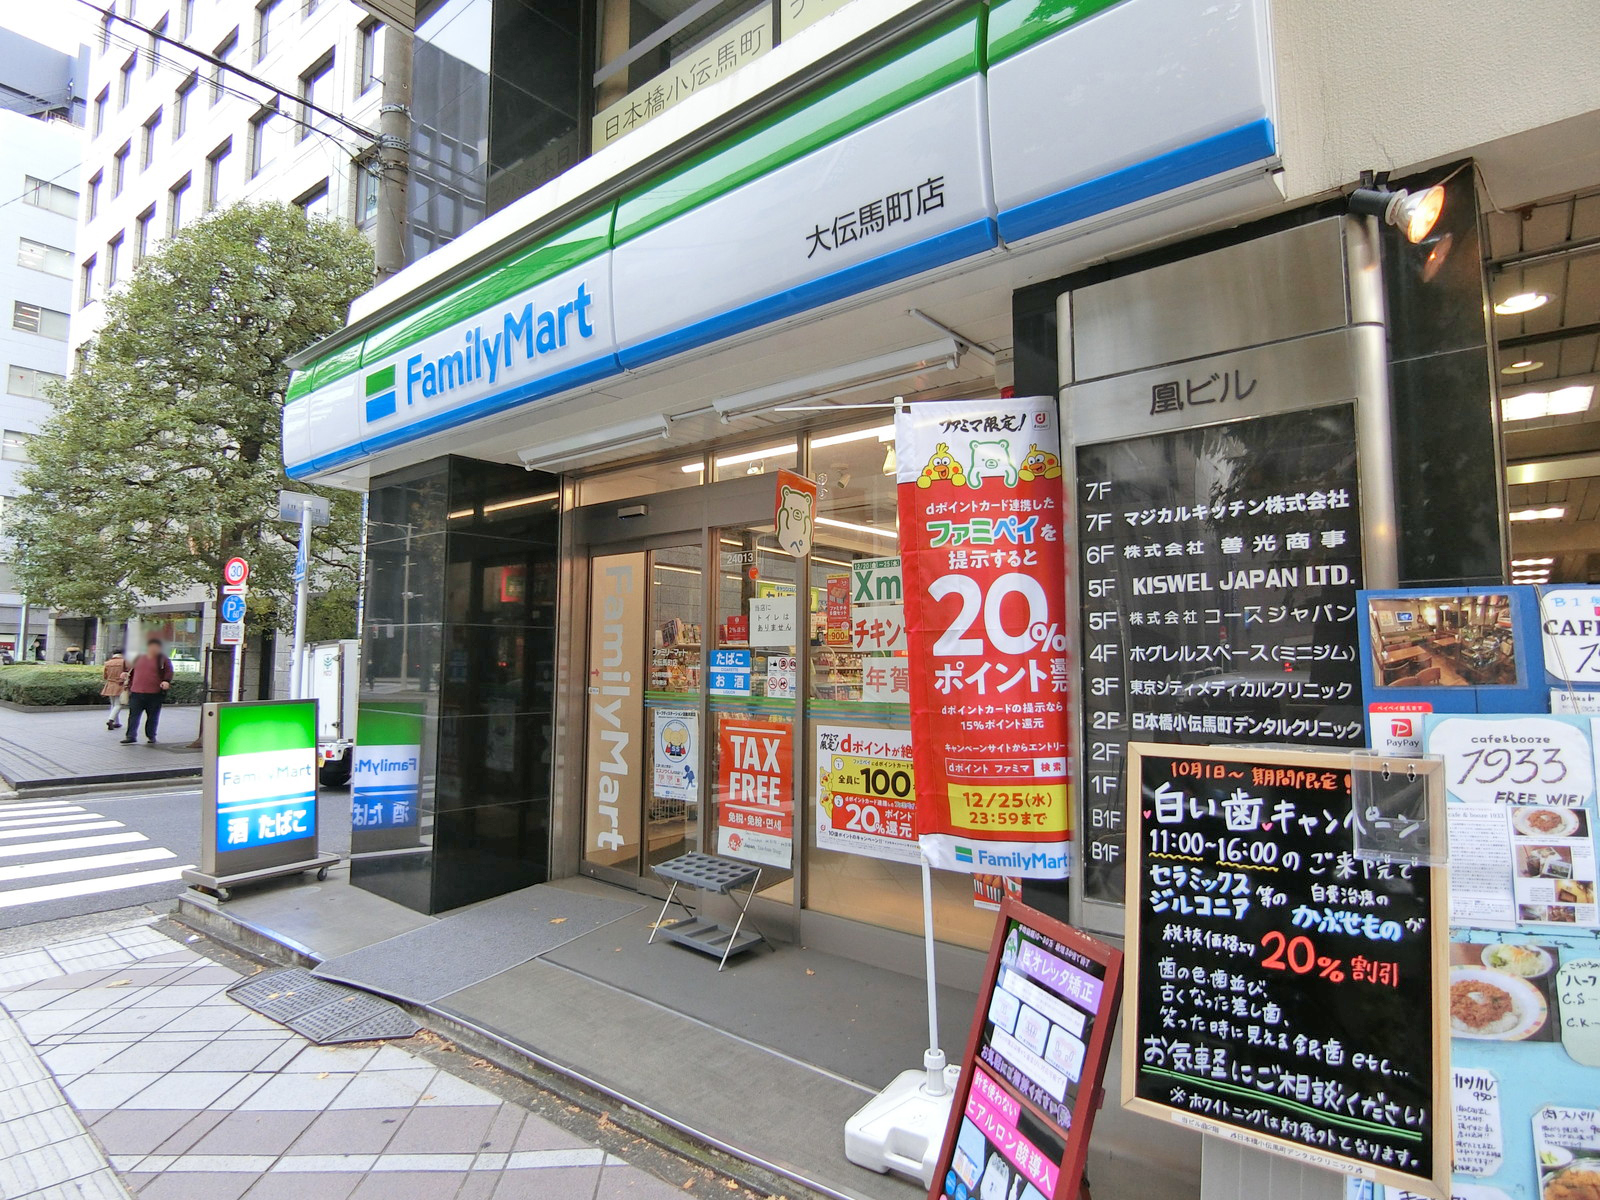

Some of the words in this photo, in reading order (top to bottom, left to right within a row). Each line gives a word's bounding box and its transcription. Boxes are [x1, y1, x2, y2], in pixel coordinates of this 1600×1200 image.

[605, 23, 766, 141] 日本橋小伝馬町
[805, 175, 945, 258] 大伝馬町店
[407, 281, 593, 405] FamilyMart
[1086, 481, 1112, 502] 7F
[926, 496, 1054, 516] dポイントカード連携した
[1086, 513, 1112, 533] 7F
[1124, 488, 1350, 527] マジカルキッチン株式会社
[727, 552, 754, 564] 24013
[948, 548, 1038, 570] 提示すると
[1086, 544, 1114, 565] 6F
[1123, 540, 1205, 560] 株式会社
[230, 565, 242, 577] 30
[1088, 578, 1115, 598] 5F
[1132, 572, 1213, 596] KISWEL
[1219, 567, 1298, 590] JAPAN
[1306, 564, 1356, 587] LTD.
[928, 572, 1067, 656] 20%
[1089, 611, 1117, 631] 5F
[1129, 610, 1198, 625] 株式会社
[1205, 605, 1356, 625] コースジャパン
[757, 623, 792, 632] ありません
[716, 652, 744, 665] たばこ
[1089, 644, 1118, 663] 4F
[1129, 644, 1355, 662] ホグレルスペース(ミニジム)
[934, 659, 1047, 695] ポイント
[1091, 677, 1119, 696] 3F
[1130, 679, 1353, 699] 東京シティメディカルクリニック
[593, 565, 633, 851] FamilyMart
[941, 701, 1063, 715] dポイントカードの提示なら
[960, 718, 1045, 731] 15%ポイント還元
[1093, 712, 1120, 730] 2F
[1132, 712, 1362, 740] 日本橋小伝馬町デンタルクリニック
[1386, 738, 1420, 749] PayPay
[1471, 734, 1550, 744] cafe&booze
[730, 735, 781, 773] TAX
[1092, 743, 1120, 762] 2F
[222, 763, 312, 786] FamMart
[949, 764, 988, 773] dポイント
[995, 764, 1029, 773] ファミマ
[1041, 761, 1062, 772] 検索
[1457, 748, 1567, 785] 1933
[730, 771, 781, 807] FREE
[838, 774, 860, 784] 全員に
[860, 767, 911, 798] 100
[1091, 775, 1117, 794] 1F
[962, 791, 1053, 809] 12/25(水)
[1154, 781, 1263, 832] 白い歯
[1494, 790, 1538, 806] FREE
[1546, 793, 1584, 807] WIFI
[228, 816, 249, 844] 酒
[259, 810, 307, 839] たばこ
[846, 803, 885, 834] 20%
[885, 809, 912, 821] ポイント
[885, 821, 912, 838] 還元
[969, 811, 1048, 826] 23:59まで
[1092, 809, 1121, 829] B1F
[978, 849, 1068, 870] FamilyMart
[1092, 842, 1119, 863] B1F
[1149, 864, 1251, 895] セラミックス
[1148, 890, 1250, 920] ジルコニア
[1310, 883, 1390, 907] 自費治療の
[1261, 931, 1346, 982] 20%
[1351, 955, 1399, 988] 割引
[1022, 945, 1093, 1003] ビオレッタ矯正
[1143, 1034, 1426, 1126] お気軽にご相談ください
[974, 1070, 1018, 1117] 針を使わない
[967, 1093, 1053, 1192] ヒアルロン酸導入
